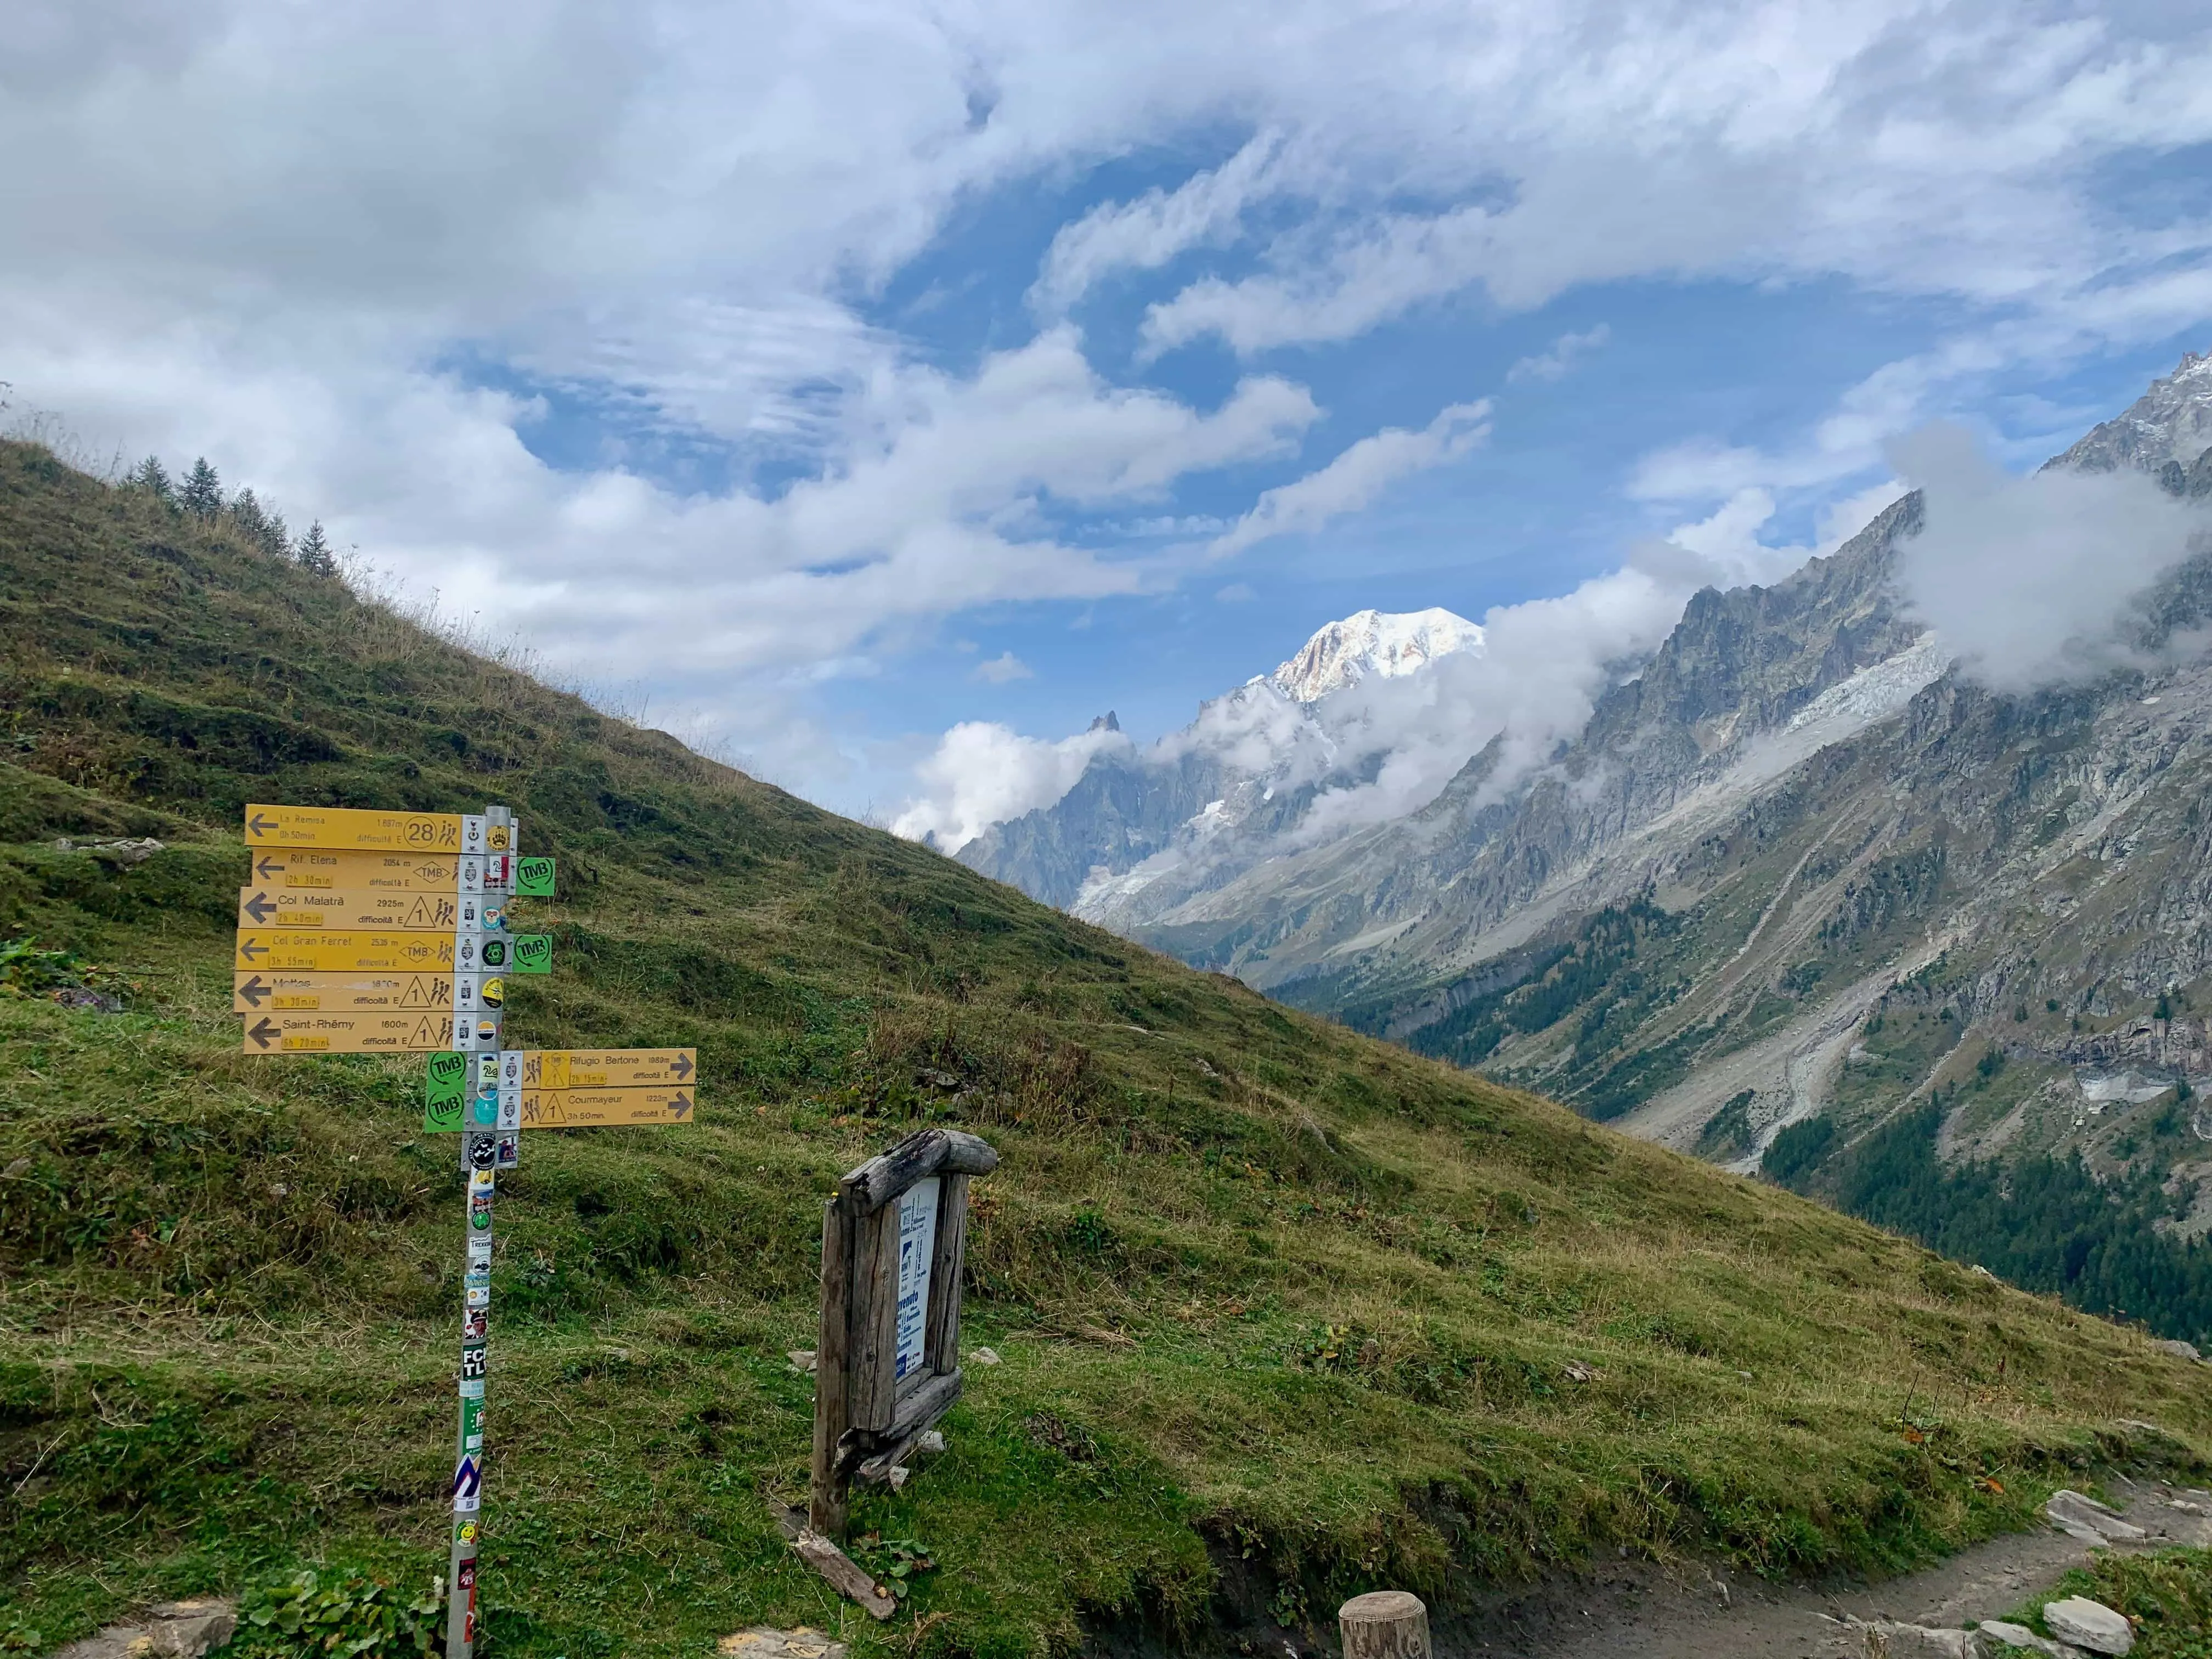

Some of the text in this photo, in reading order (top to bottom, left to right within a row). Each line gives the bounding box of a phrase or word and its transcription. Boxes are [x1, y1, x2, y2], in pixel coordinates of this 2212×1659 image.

[409, 823, 433, 841] 28
[397, 836, 402, 844] E
[311, 855, 337, 865] Elena
[422, 868, 443, 877] TMB
[520, 862, 548, 878] TMB
[278, 895, 344, 905] Col Malatrà
[377, 899, 404, 907] 2925m
[415, 909, 422, 922] 1
[273, 935, 352, 946] Col Gran Ferret
[408, 947, 428, 956] TMB
[518, 939, 545, 957] TMB
[272, 957, 281, 966] 3h
[411, 989, 417, 1002] 1
[283, 1019, 355, 1030] Saint-Rhémy
[420, 1029, 426, 1042] 1
[433, 1056, 461, 1075] TMB
[570, 1056, 639, 1066] Rifugio Bertone
[431, 1096, 460, 1116] TMB
[568, 1096, 622, 1105] Courmayeur
[549, 1105, 555, 1119] 1
